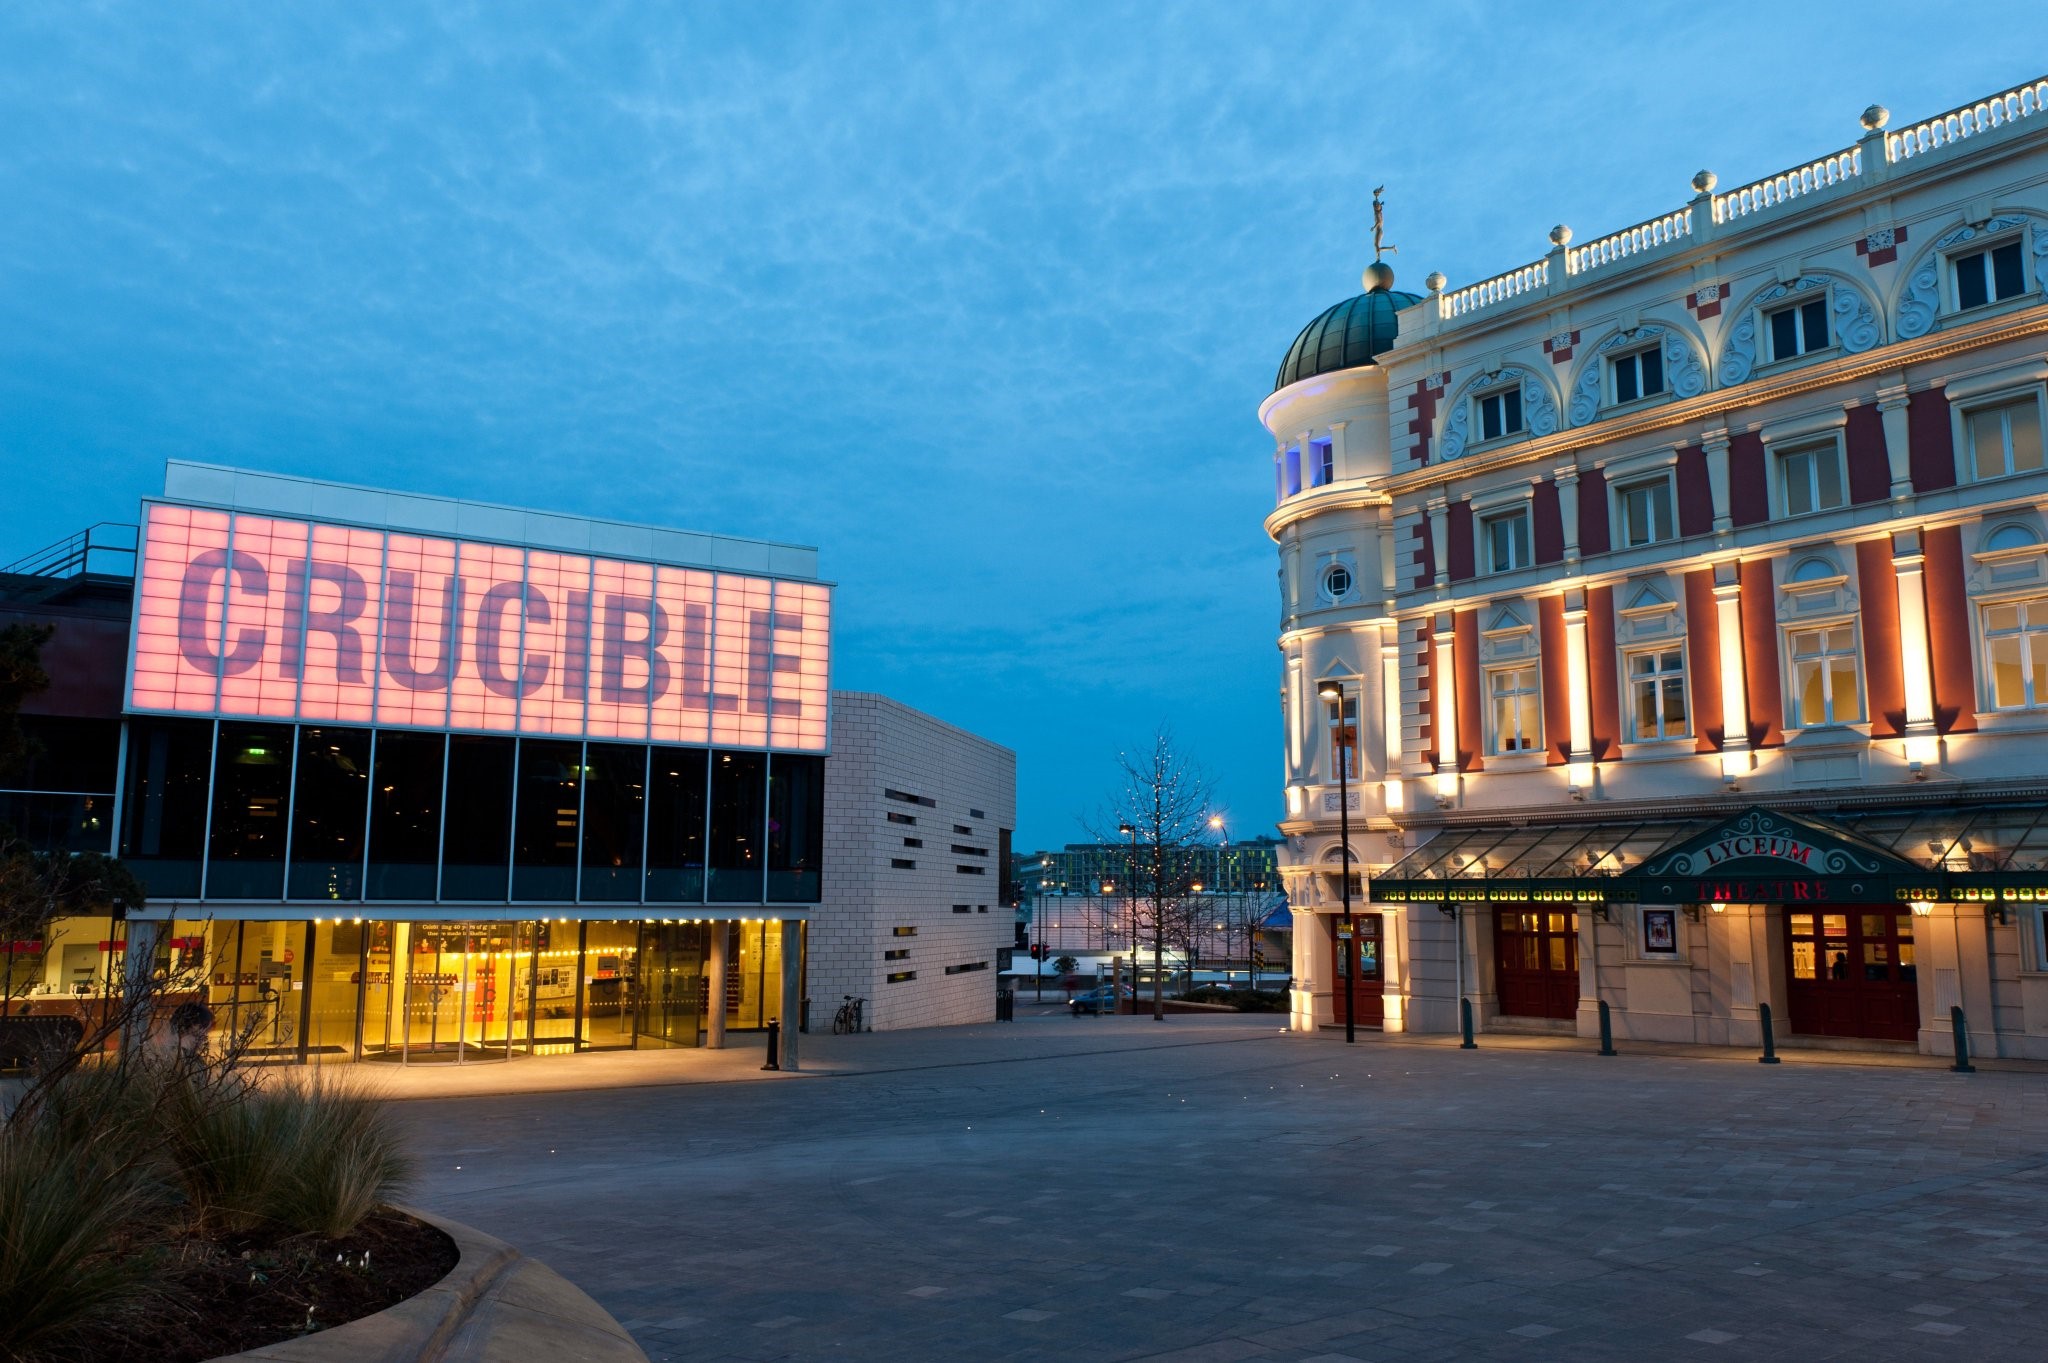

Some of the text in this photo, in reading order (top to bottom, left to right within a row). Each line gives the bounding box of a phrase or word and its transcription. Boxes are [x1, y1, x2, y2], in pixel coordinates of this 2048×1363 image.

[178, 548, 803, 717] CRUCIBLE
[1703, 837, 1813, 865] LYCEUM
[1695, 881, 1830, 900] THEATRE
